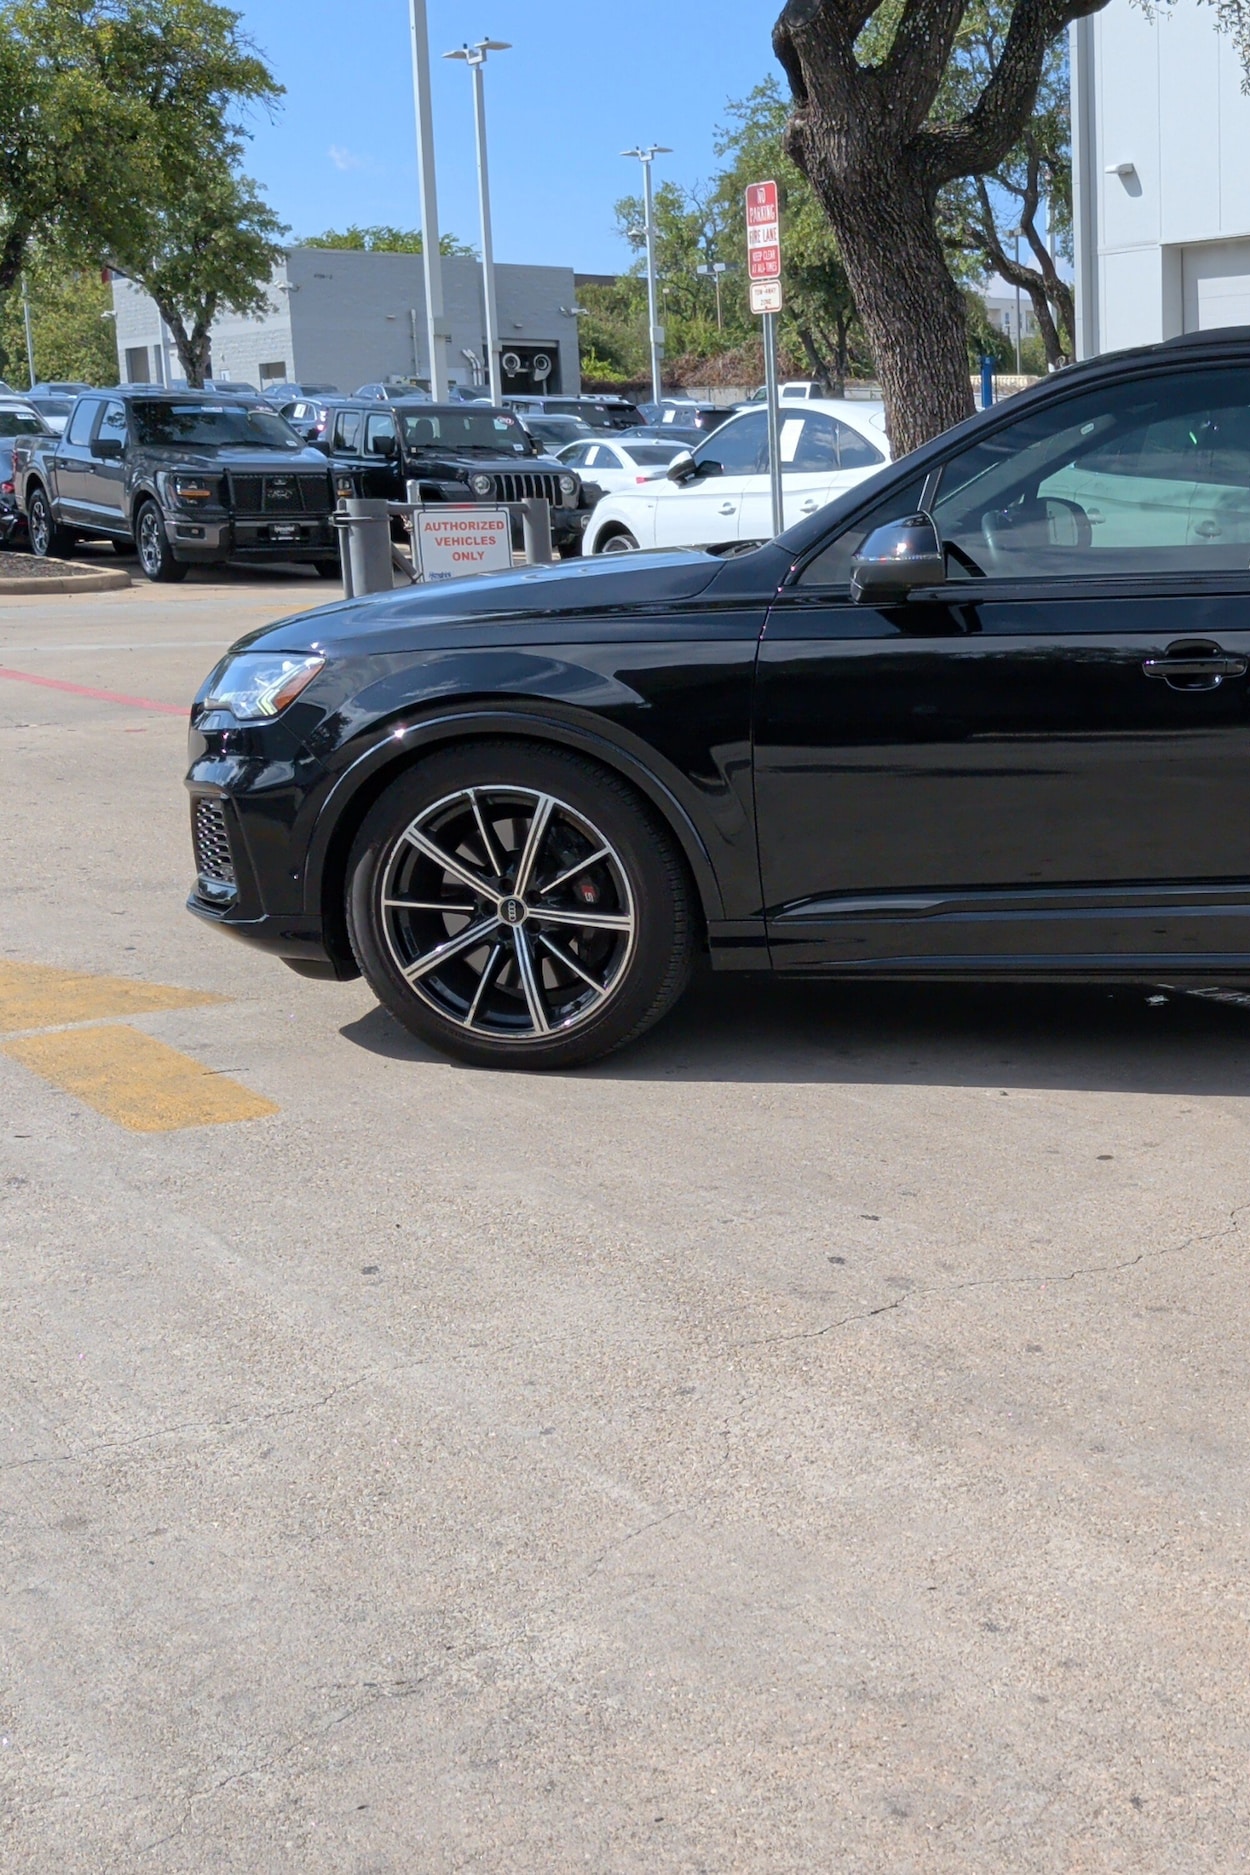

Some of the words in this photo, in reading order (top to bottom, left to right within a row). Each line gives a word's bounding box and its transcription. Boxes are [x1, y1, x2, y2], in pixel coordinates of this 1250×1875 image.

[757, 188, 766, 204] NO
[750, 205, 775, 222] PARKING
[749, 228, 761, 245] FIRE
[763, 227, 777, 242] LANE
[763, 249, 775, 261] CLEAR
[424, 521, 504, 531] AUTHORIZED
[435, 536, 496, 546] VEHICLES
[452, 551, 485, 561] ONLY
